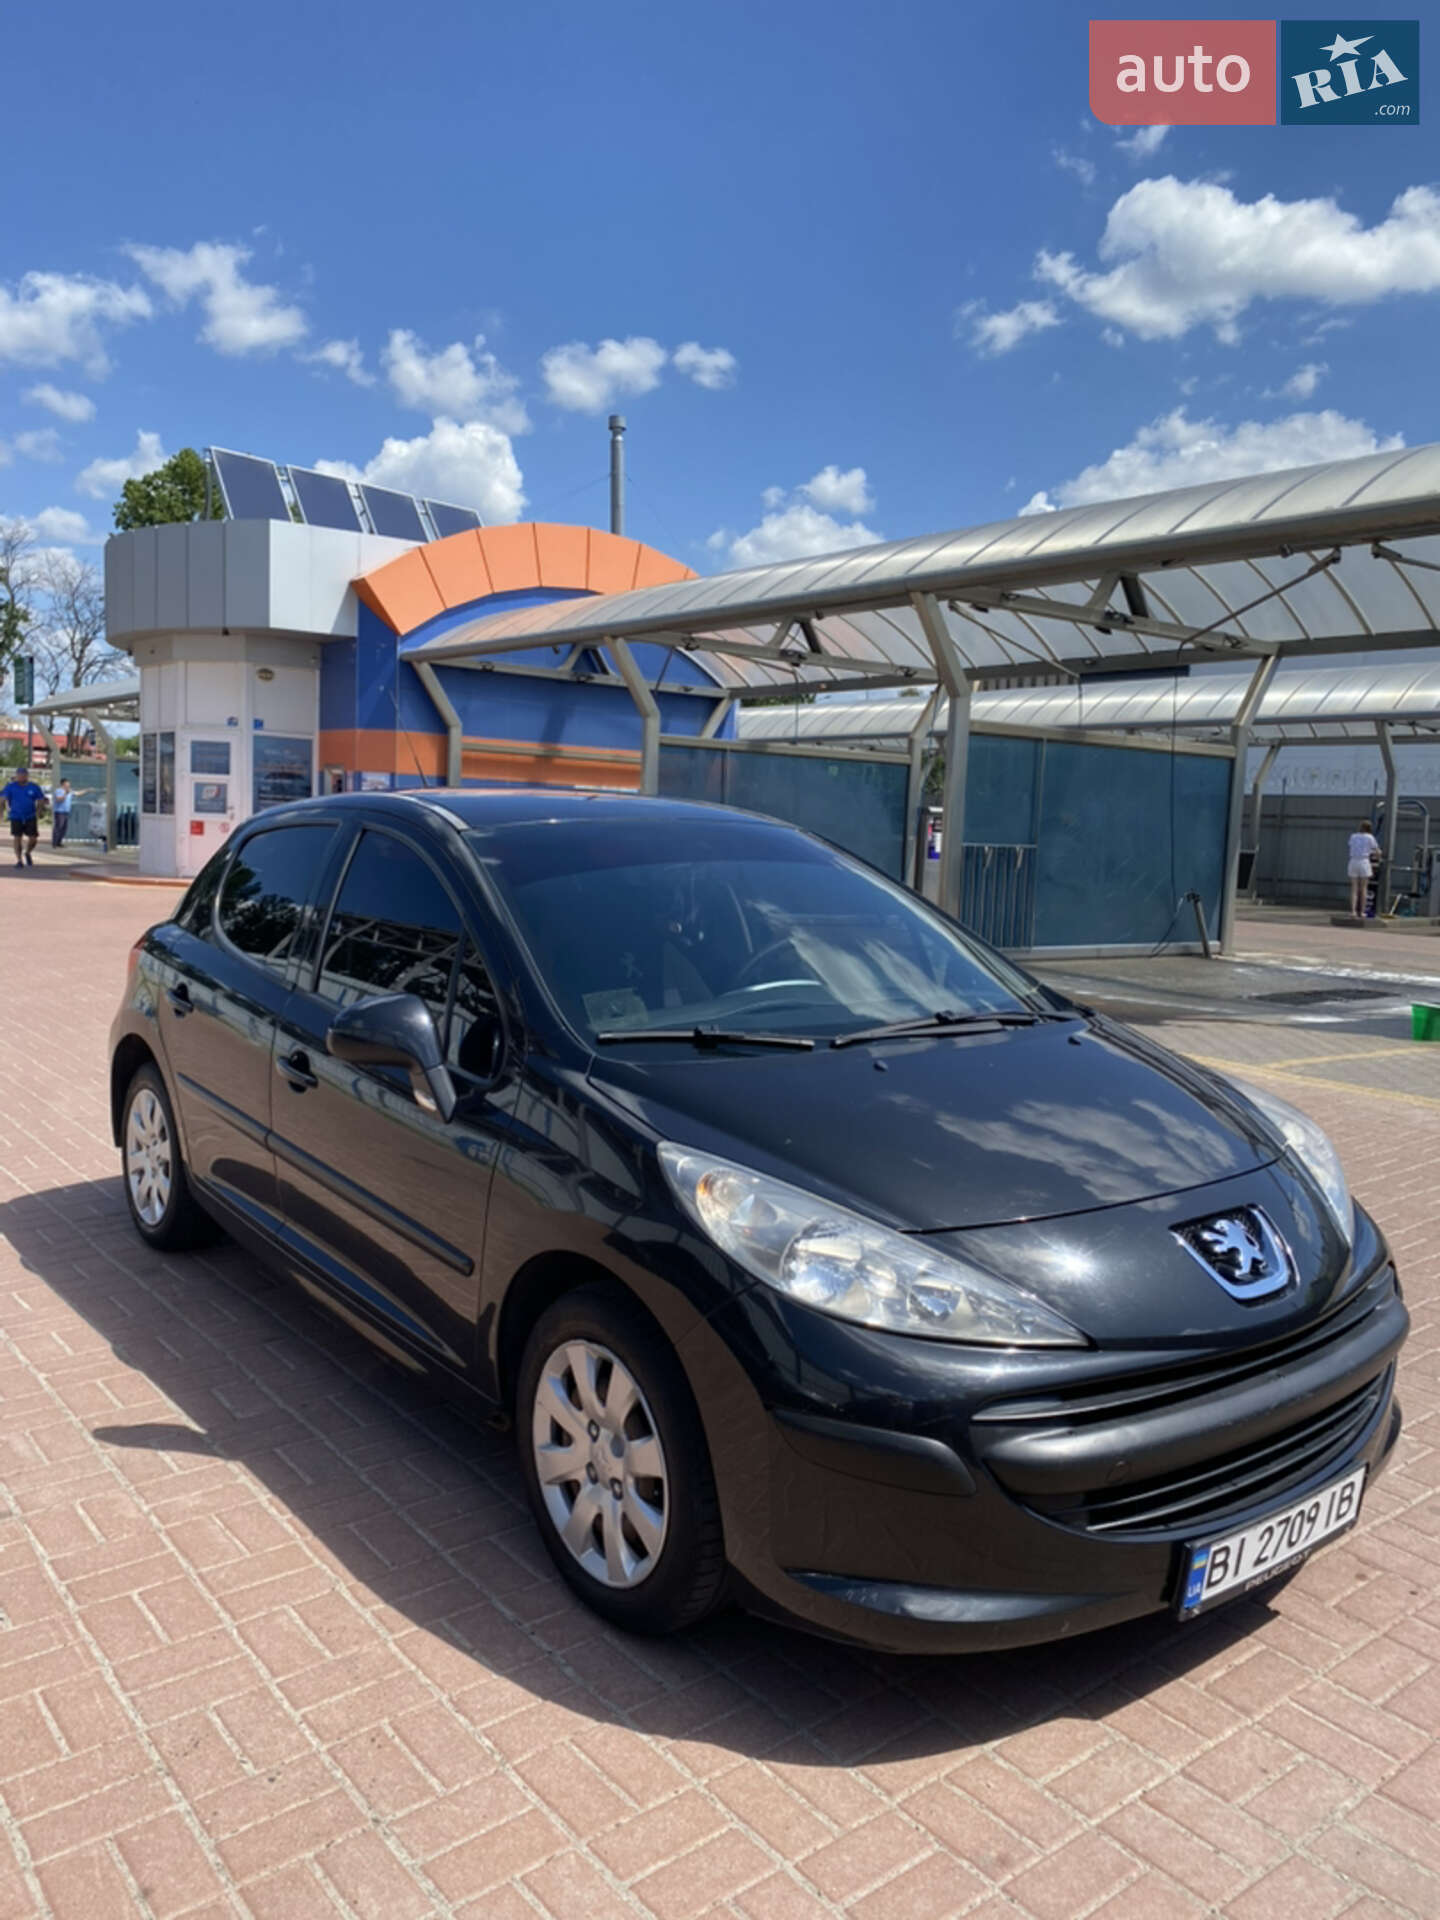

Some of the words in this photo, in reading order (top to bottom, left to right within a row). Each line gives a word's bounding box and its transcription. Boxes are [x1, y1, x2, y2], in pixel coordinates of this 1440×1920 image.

[1205, 1536, 1246, 1590] BI
[1252, 1501, 1321, 1567] 2709
[1324, 1480, 1356, 1529] IB
